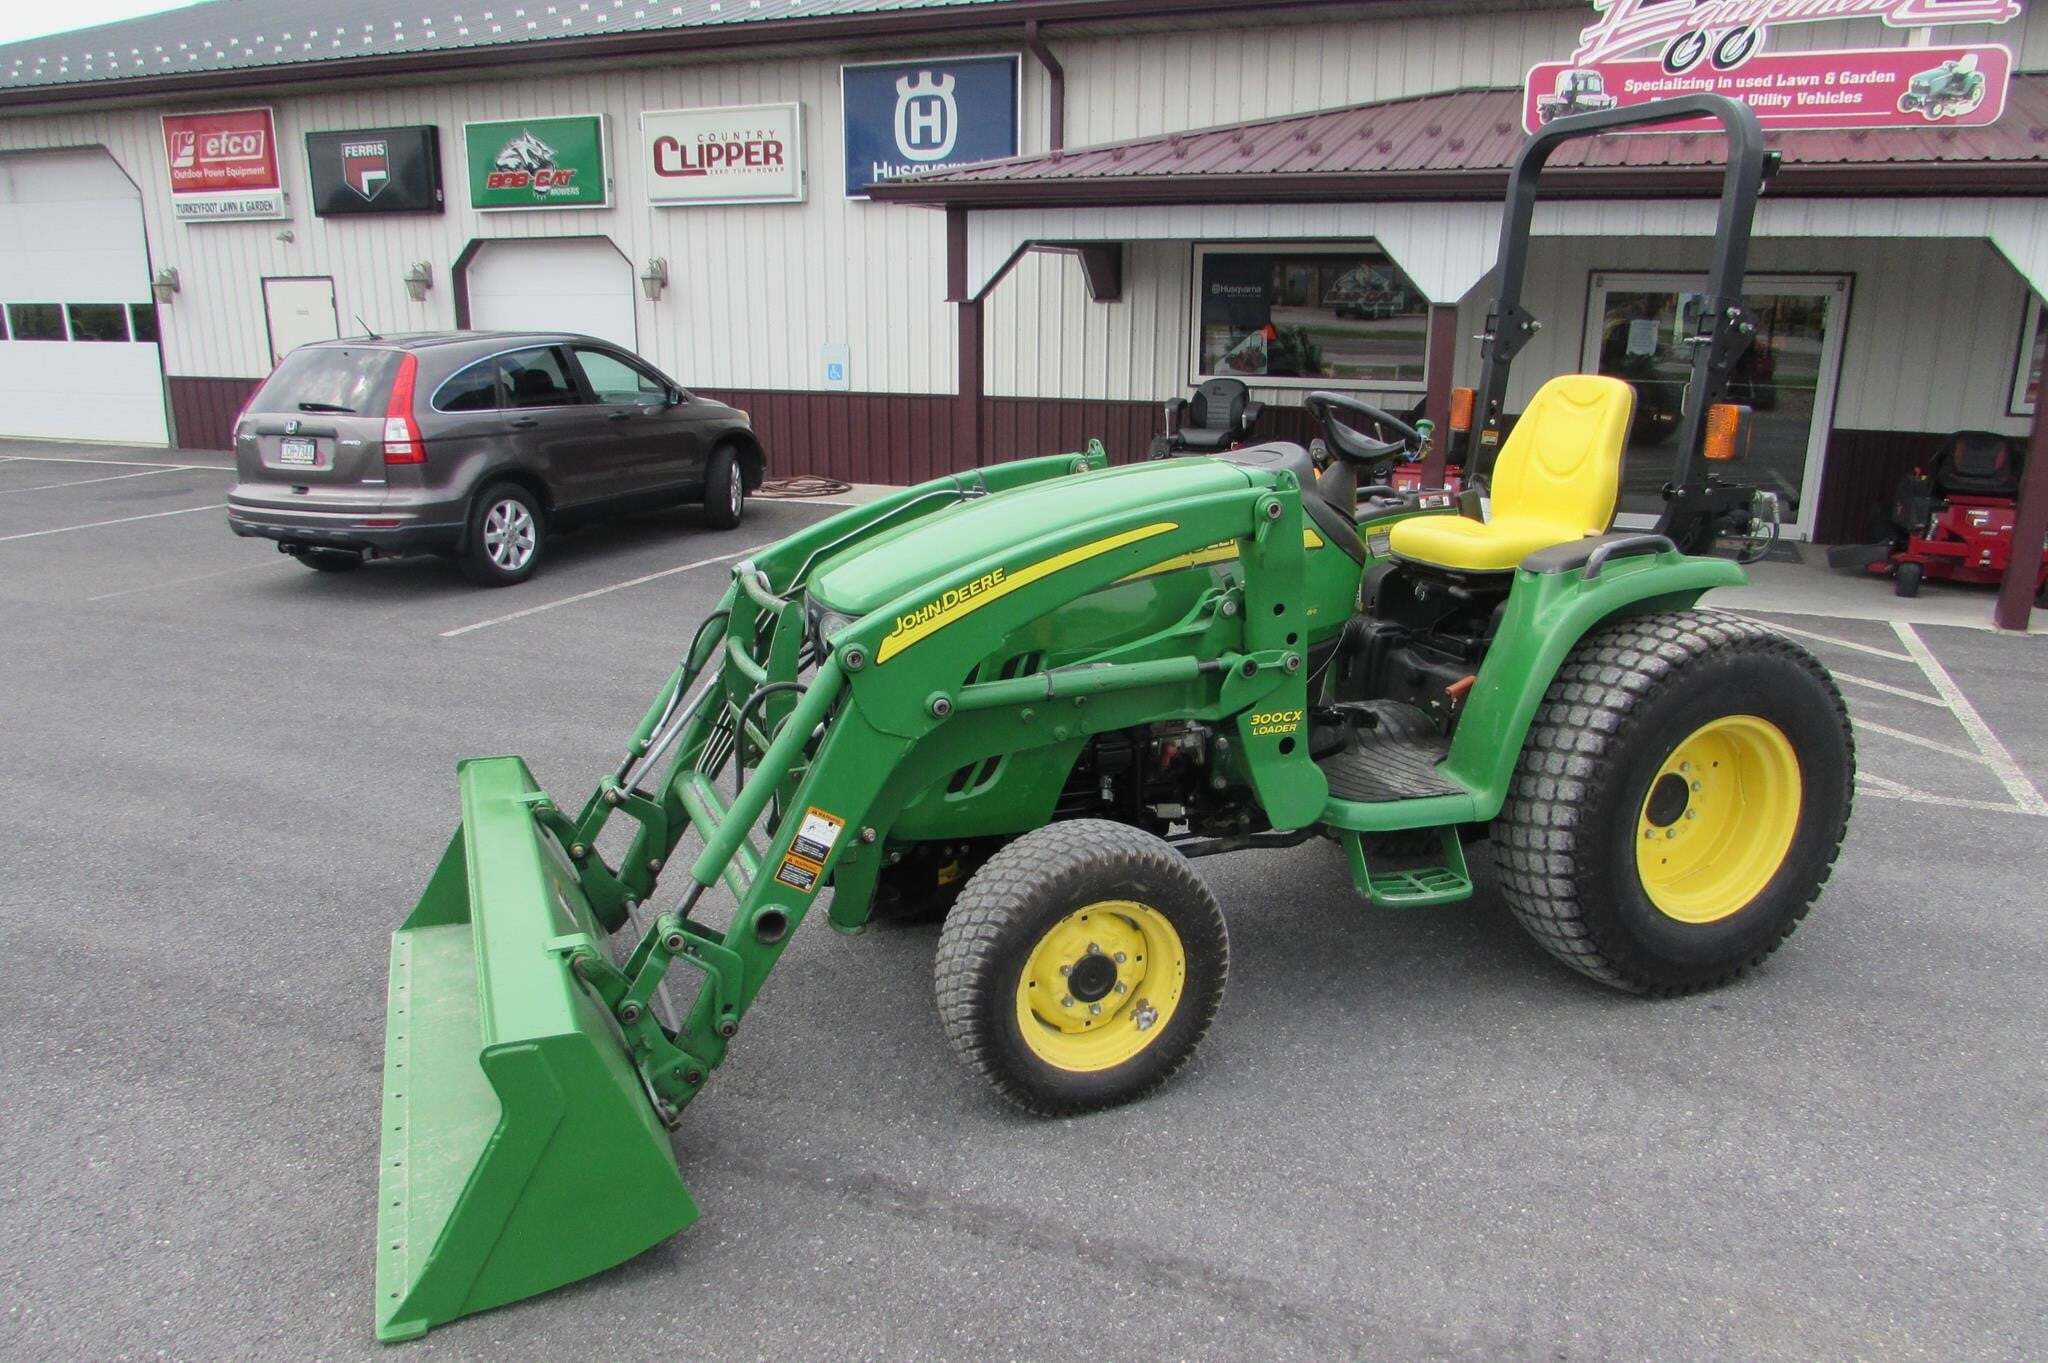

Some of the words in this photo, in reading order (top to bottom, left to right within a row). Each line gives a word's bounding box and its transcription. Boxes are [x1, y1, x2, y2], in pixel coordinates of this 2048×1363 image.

[1623, 78, 1714, 94] Specializing
[1717, 76, 1732, 88] in
[1735, 74, 1772, 88] used
[1776, 73, 1820, 87] Lawn
[1824, 72, 1836, 85] &
[1839, 70, 1896, 85] Garden
[1748, 92, 1792, 109] Utility
[1797, 91, 1863, 106] Vehicles
[206, 131, 256, 156] efco
[697, 129, 777, 143] COUNTRY
[344, 143, 385, 158] FERRIS
[653, 135, 784, 178] CLIPPER
[174, 168, 203, 179] Outdoor
[204, 167, 226, 177] Power
[226, 166, 266, 178] Equipment
[175, 203, 218, 214] TURKEYFOOT
[220, 202, 238, 213] LAWN
[245, 200, 273, 212] GARDEN
[891, 599, 944, 637] JOHN
[942, 567, 1006, 612] DEERE
[1250, 710, 1303, 726] 300CX
[1252, 723, 1297, 736] LOADER
